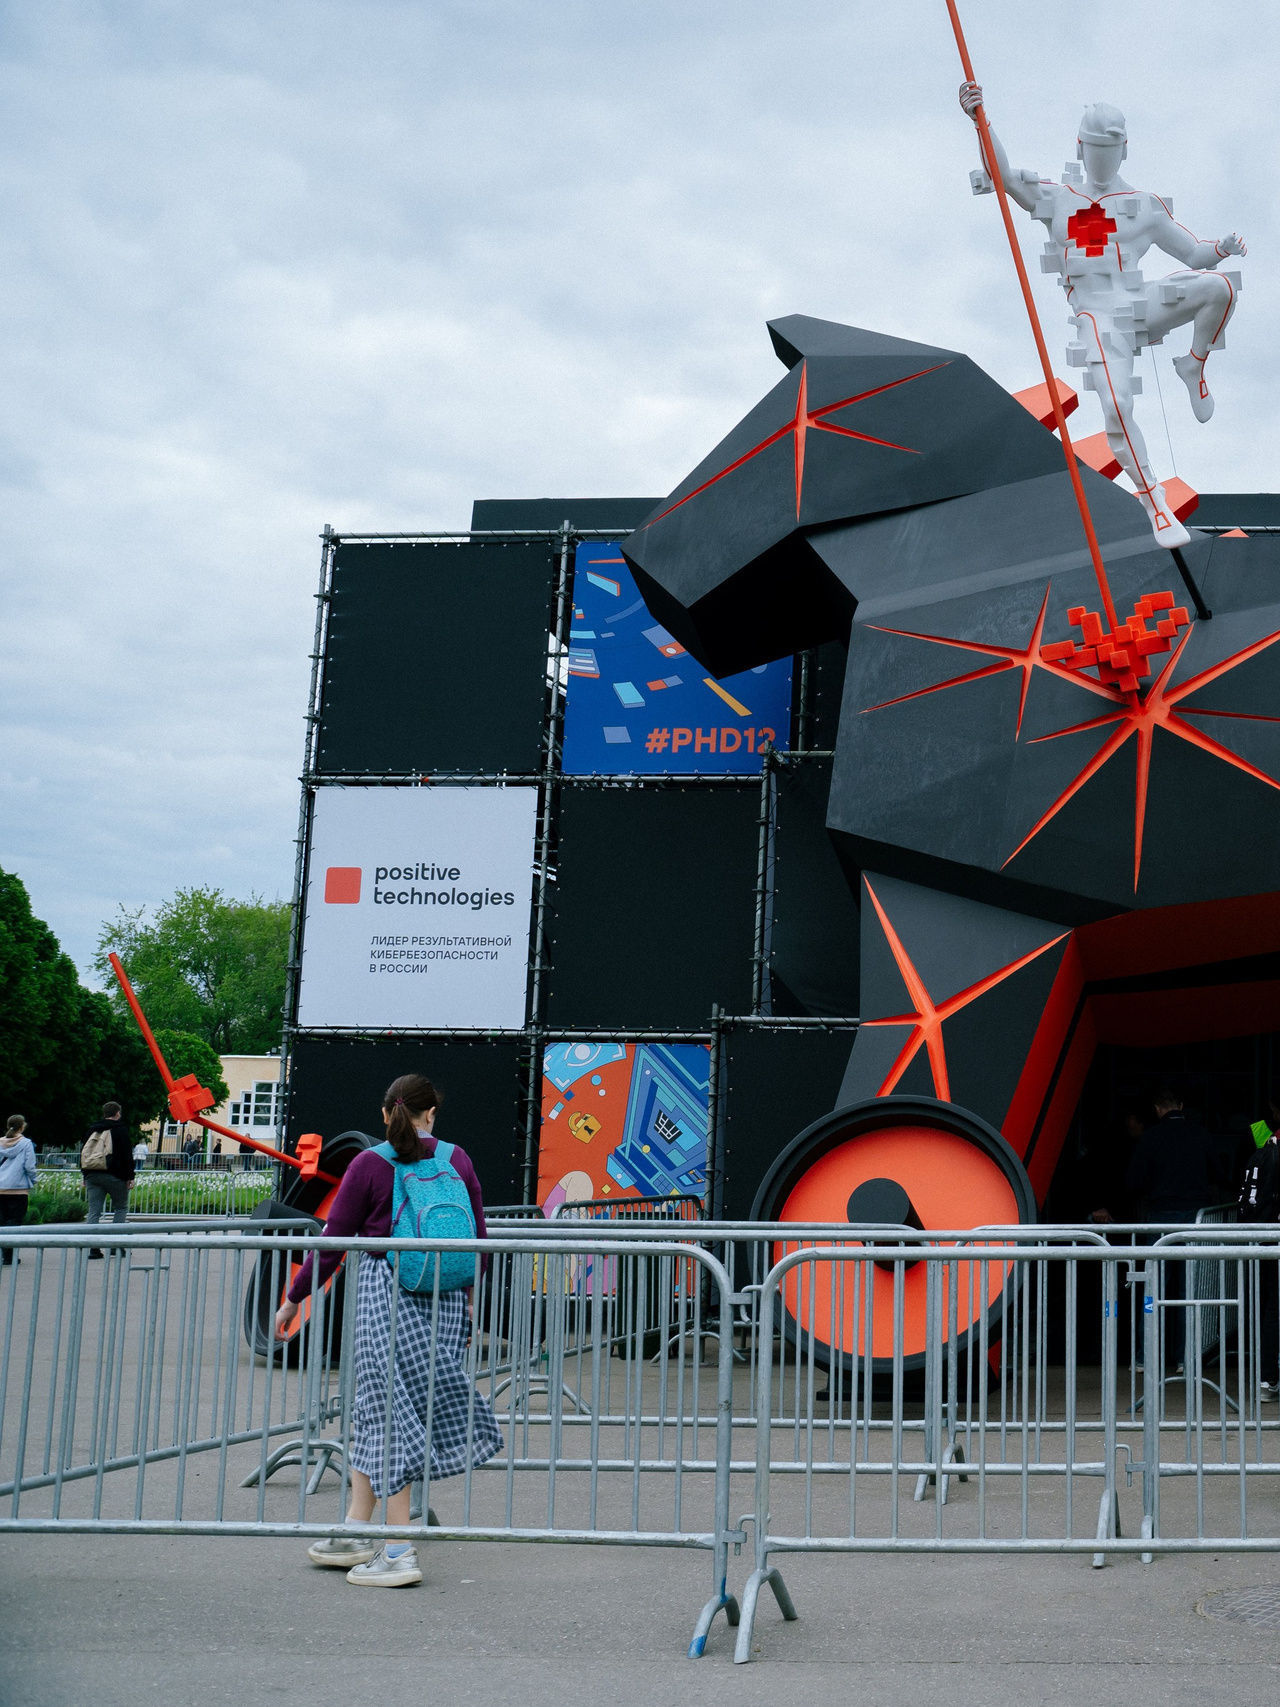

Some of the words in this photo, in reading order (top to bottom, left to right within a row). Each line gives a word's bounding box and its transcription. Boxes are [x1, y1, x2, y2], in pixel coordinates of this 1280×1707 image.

[645, 727, 776, 753] #PHD12
[375, 863, 461, 884] positive
[374, 887, 514, 910] technologies
[370, 936, 409, 946] ЛИДЕР
[411, 935, 512, 946] РЕЗУЛЬТАТИВНОЙ
[370, 950, 498, 960] КИБЕРБЕЗОПАСНОСТИ
[369, 964, 377, 973] В
[380, 964, 428, 973] РОССИИ
